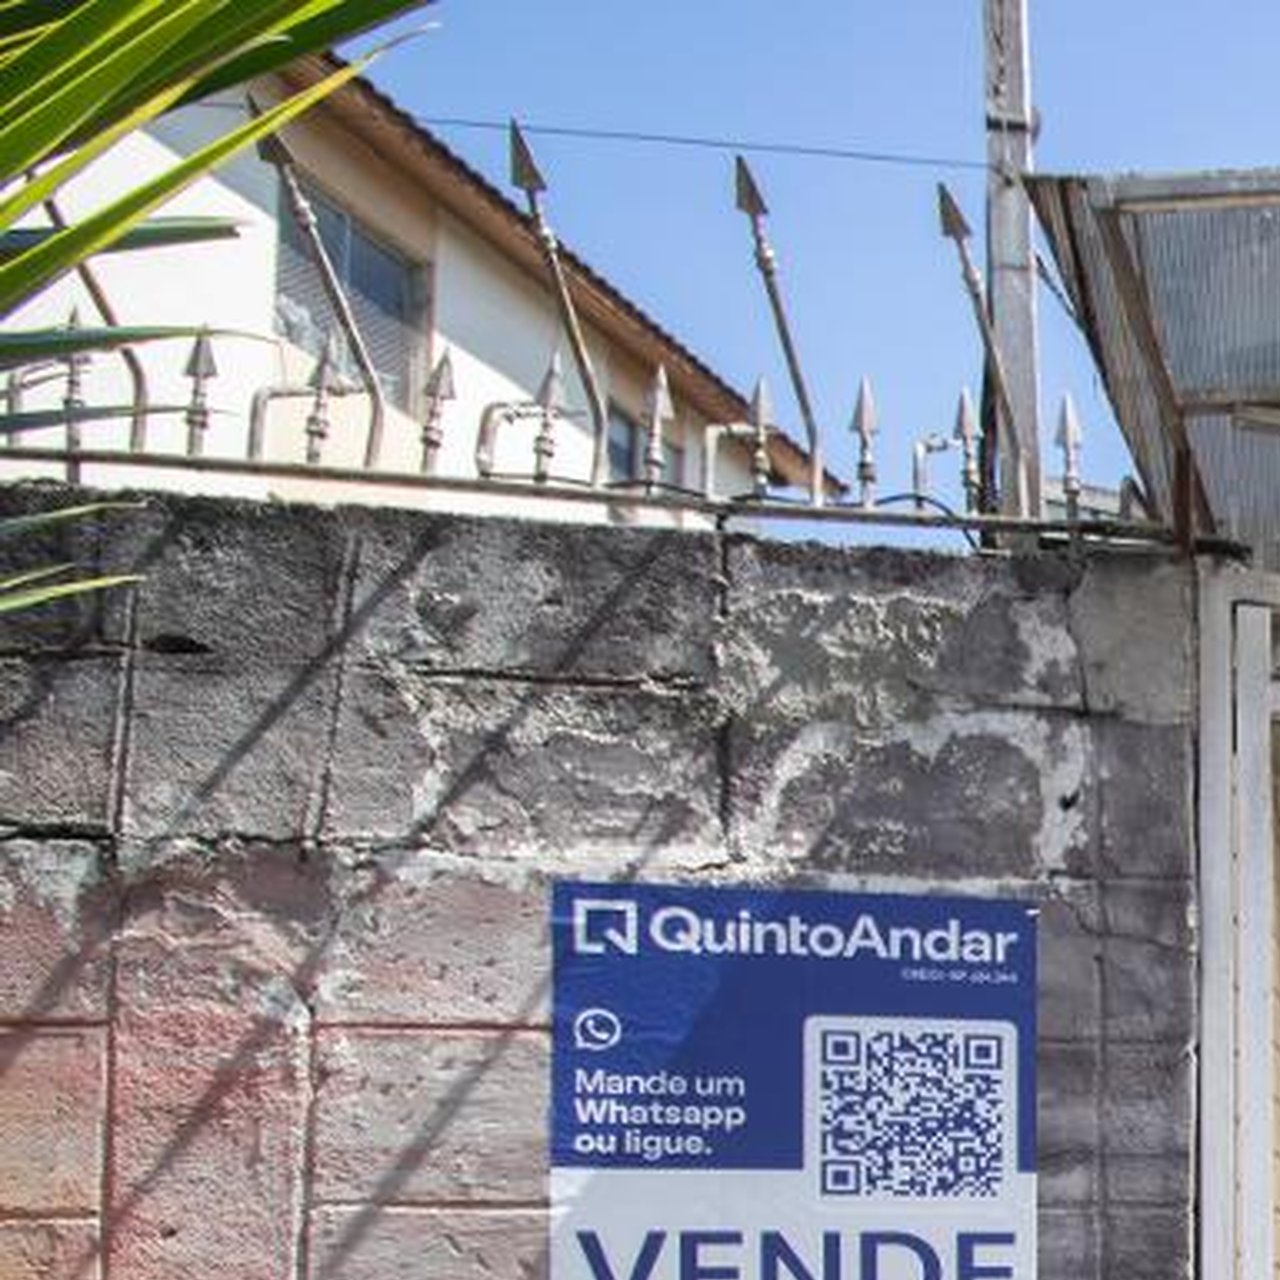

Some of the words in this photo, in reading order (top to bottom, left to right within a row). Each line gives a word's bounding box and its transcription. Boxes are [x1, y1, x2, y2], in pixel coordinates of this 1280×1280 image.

[649, 905, 1018, 963] QuintoAndar
[574, 1069, 686, 1096] Mande
[695, 1074, 746, 1097] um
[574, 1099, 746, 1132] Whatsapp
[574, 1133, 616, 1153] ou
[624, 1129, 713, 1161] ligue.
